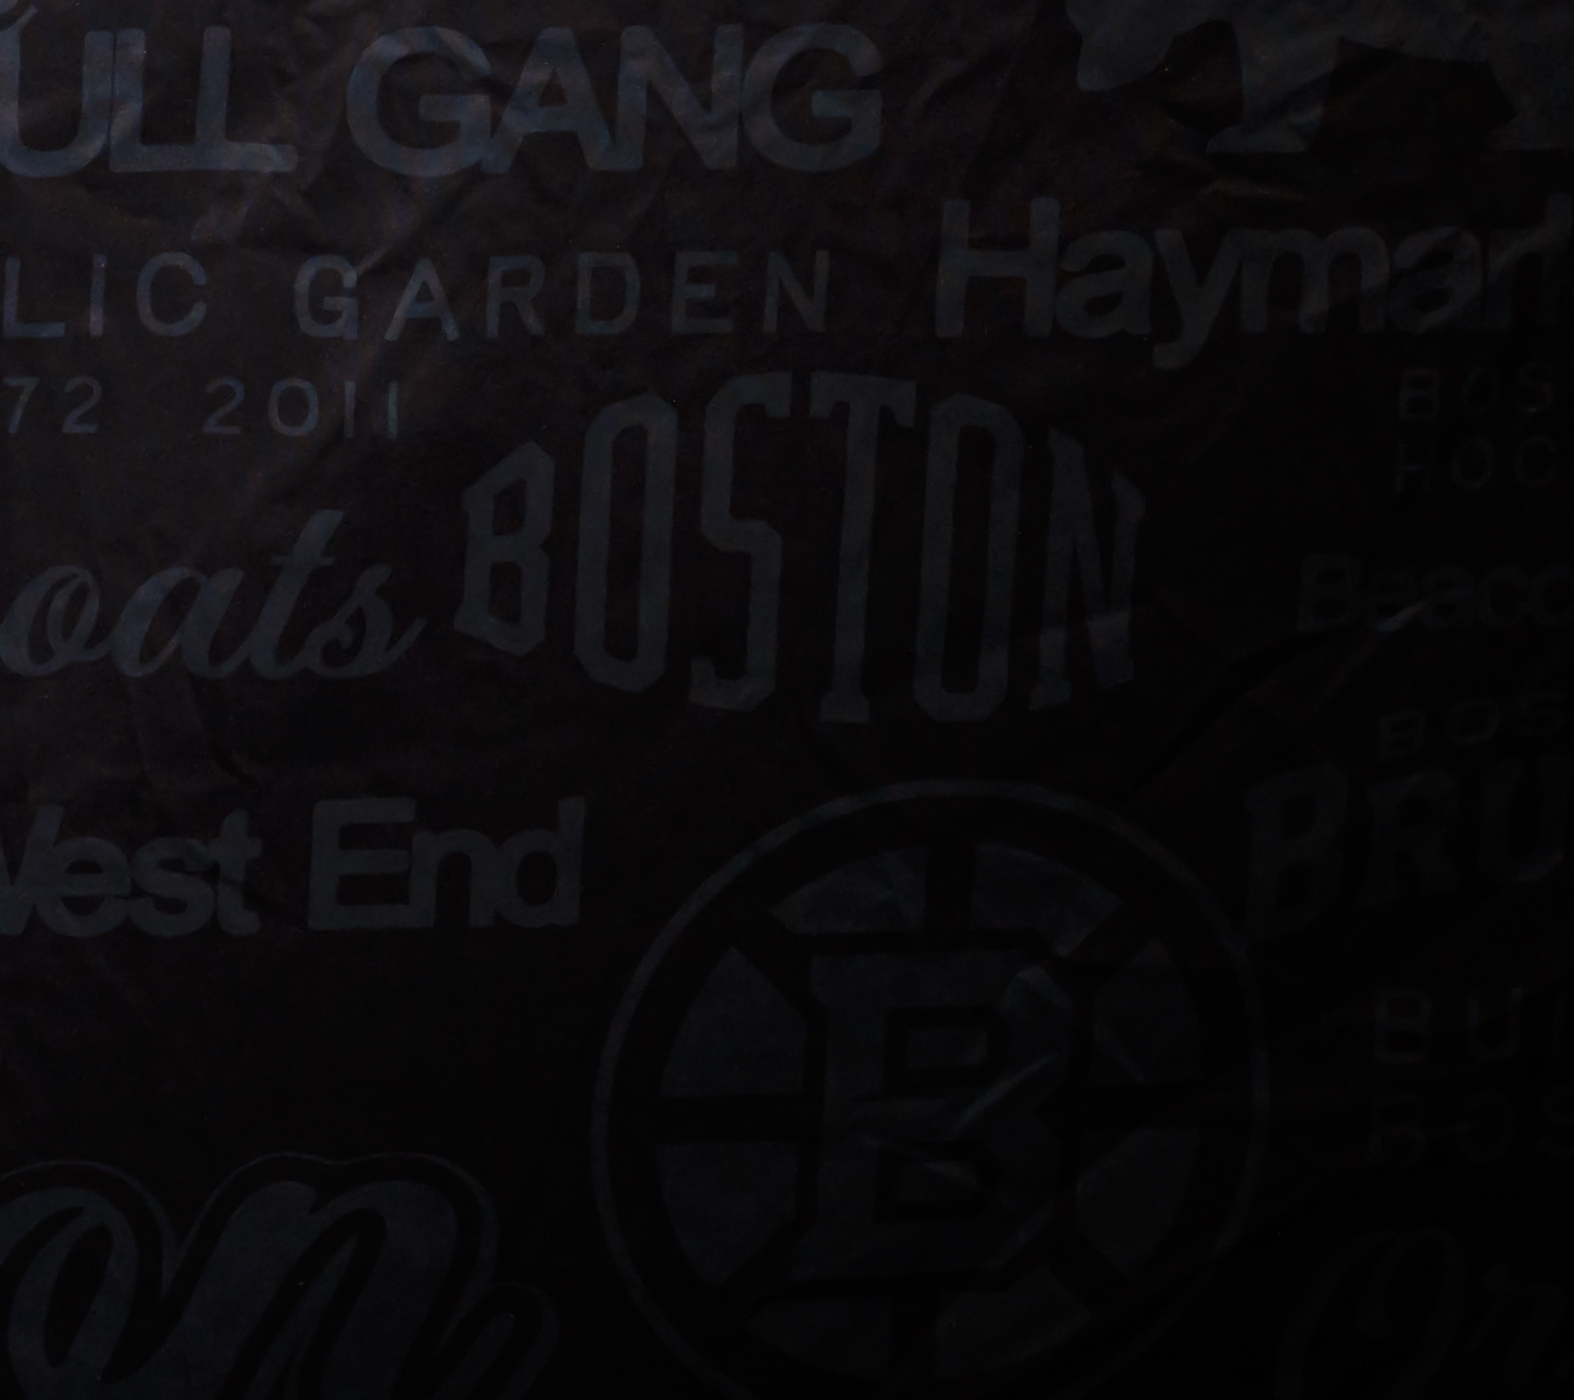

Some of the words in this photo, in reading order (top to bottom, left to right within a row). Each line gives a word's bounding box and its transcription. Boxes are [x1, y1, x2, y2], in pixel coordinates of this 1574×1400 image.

[345, 20, 884, 178] GANG
[293, 249, 831, 342] GARDEN
[202, 376, 402, 440] 2011
[454, 370, 1146, 725] BOSTON
[308, 796, 587, 931] End
